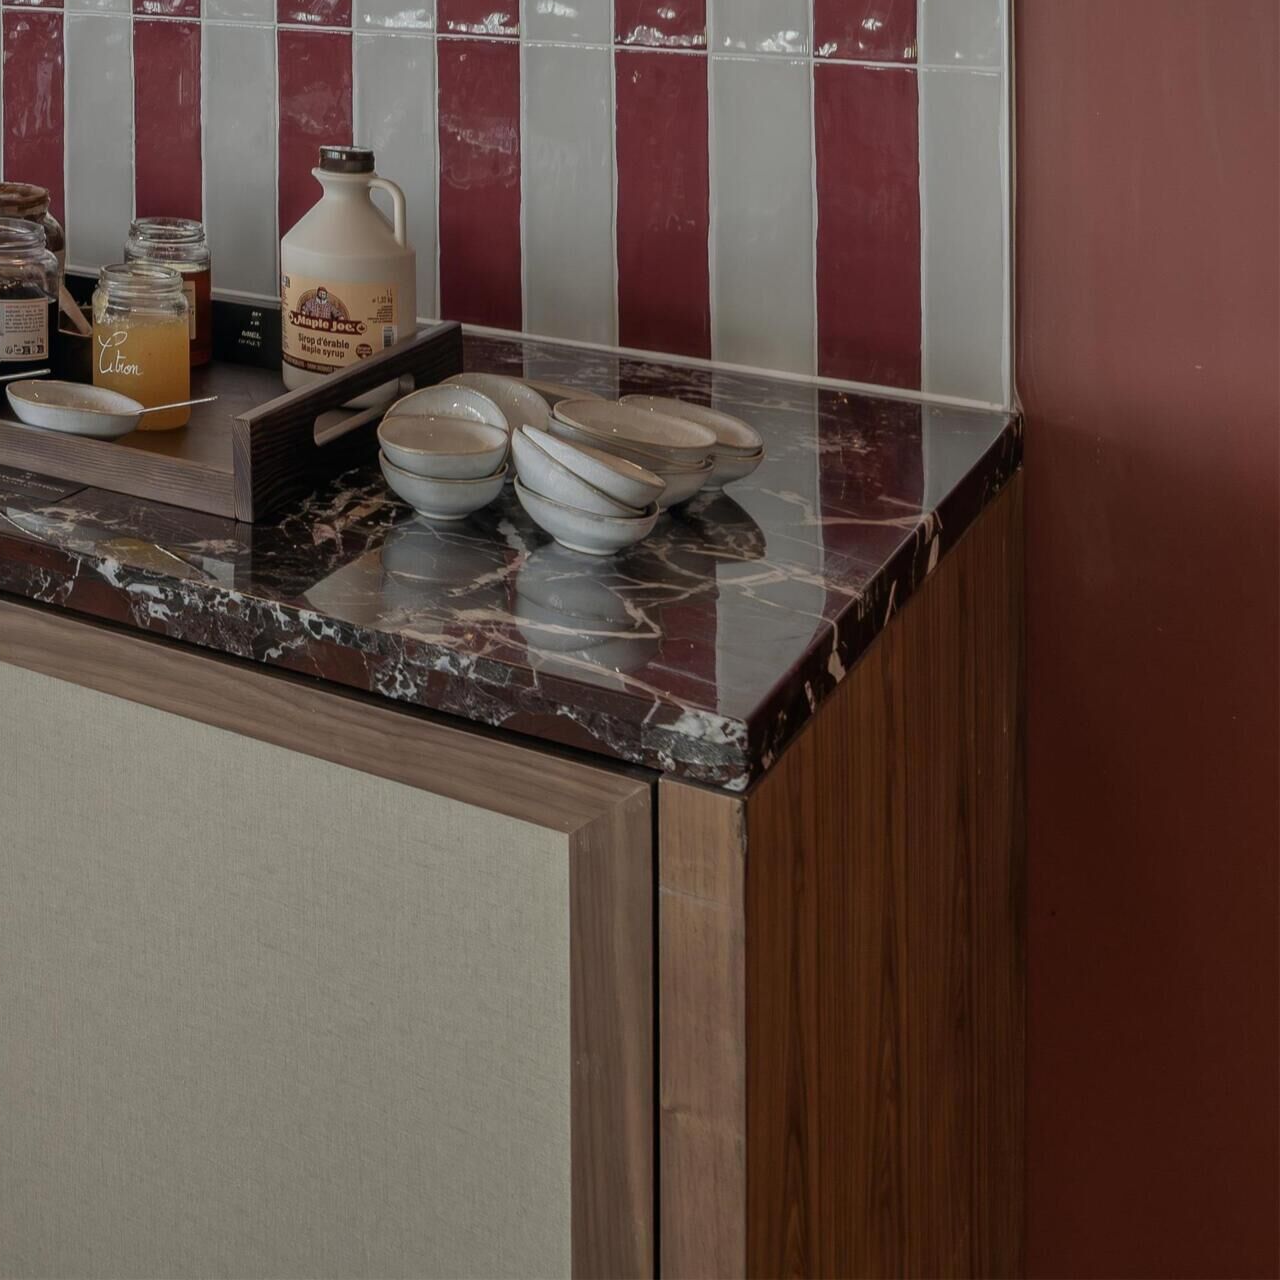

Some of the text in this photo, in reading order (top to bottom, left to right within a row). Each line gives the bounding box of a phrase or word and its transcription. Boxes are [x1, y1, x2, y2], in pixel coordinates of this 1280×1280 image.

[293, 315, 330, 329] Maple
[298, 333, 350, 349] Sirop d'érable
[98, 331, 144, 376] Citron
[301, 343, 321, 355] Maple
[322, 348, 345, 359] syrup
